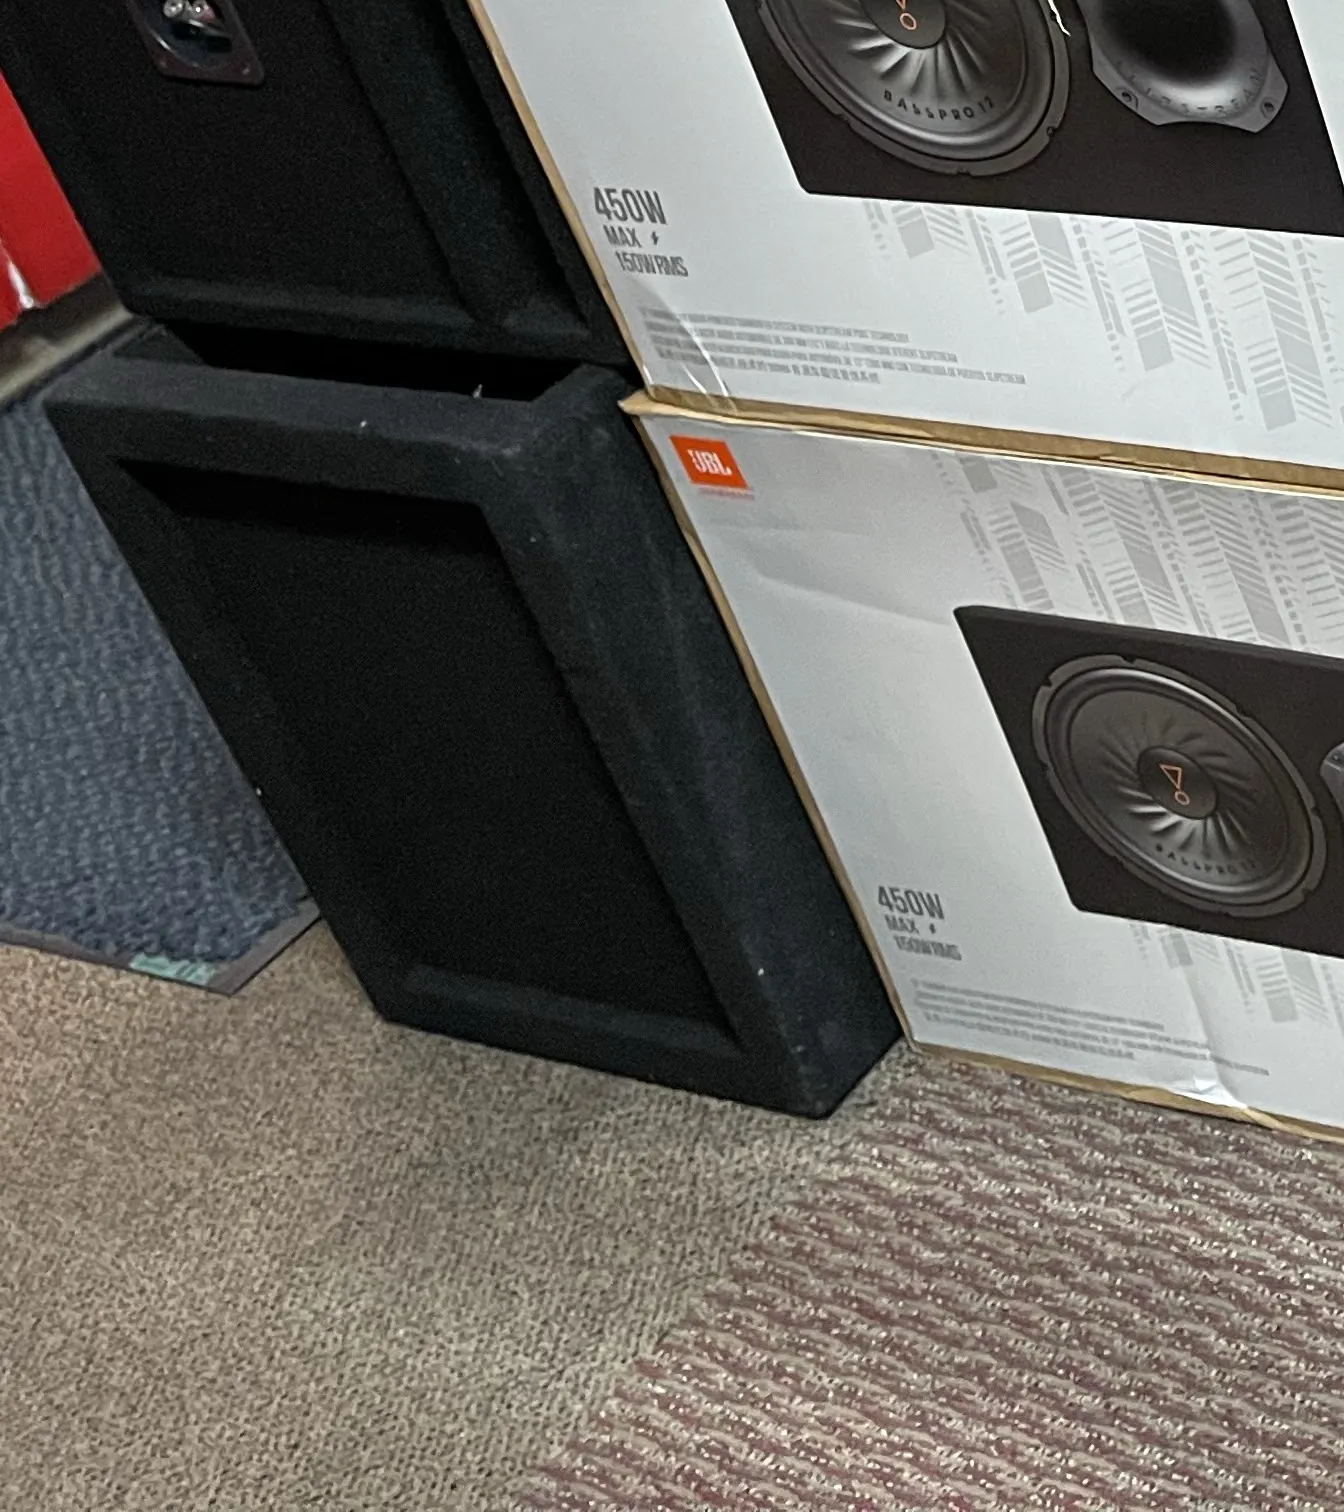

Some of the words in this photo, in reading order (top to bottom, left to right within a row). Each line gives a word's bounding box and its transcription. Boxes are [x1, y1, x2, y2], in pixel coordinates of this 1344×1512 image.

[594, 187, 667, 225] 450W
[603, 224, 642, 248] MAX
[687, 449, 732, 476] JBL
[878, 886, 945, 920] 450W
